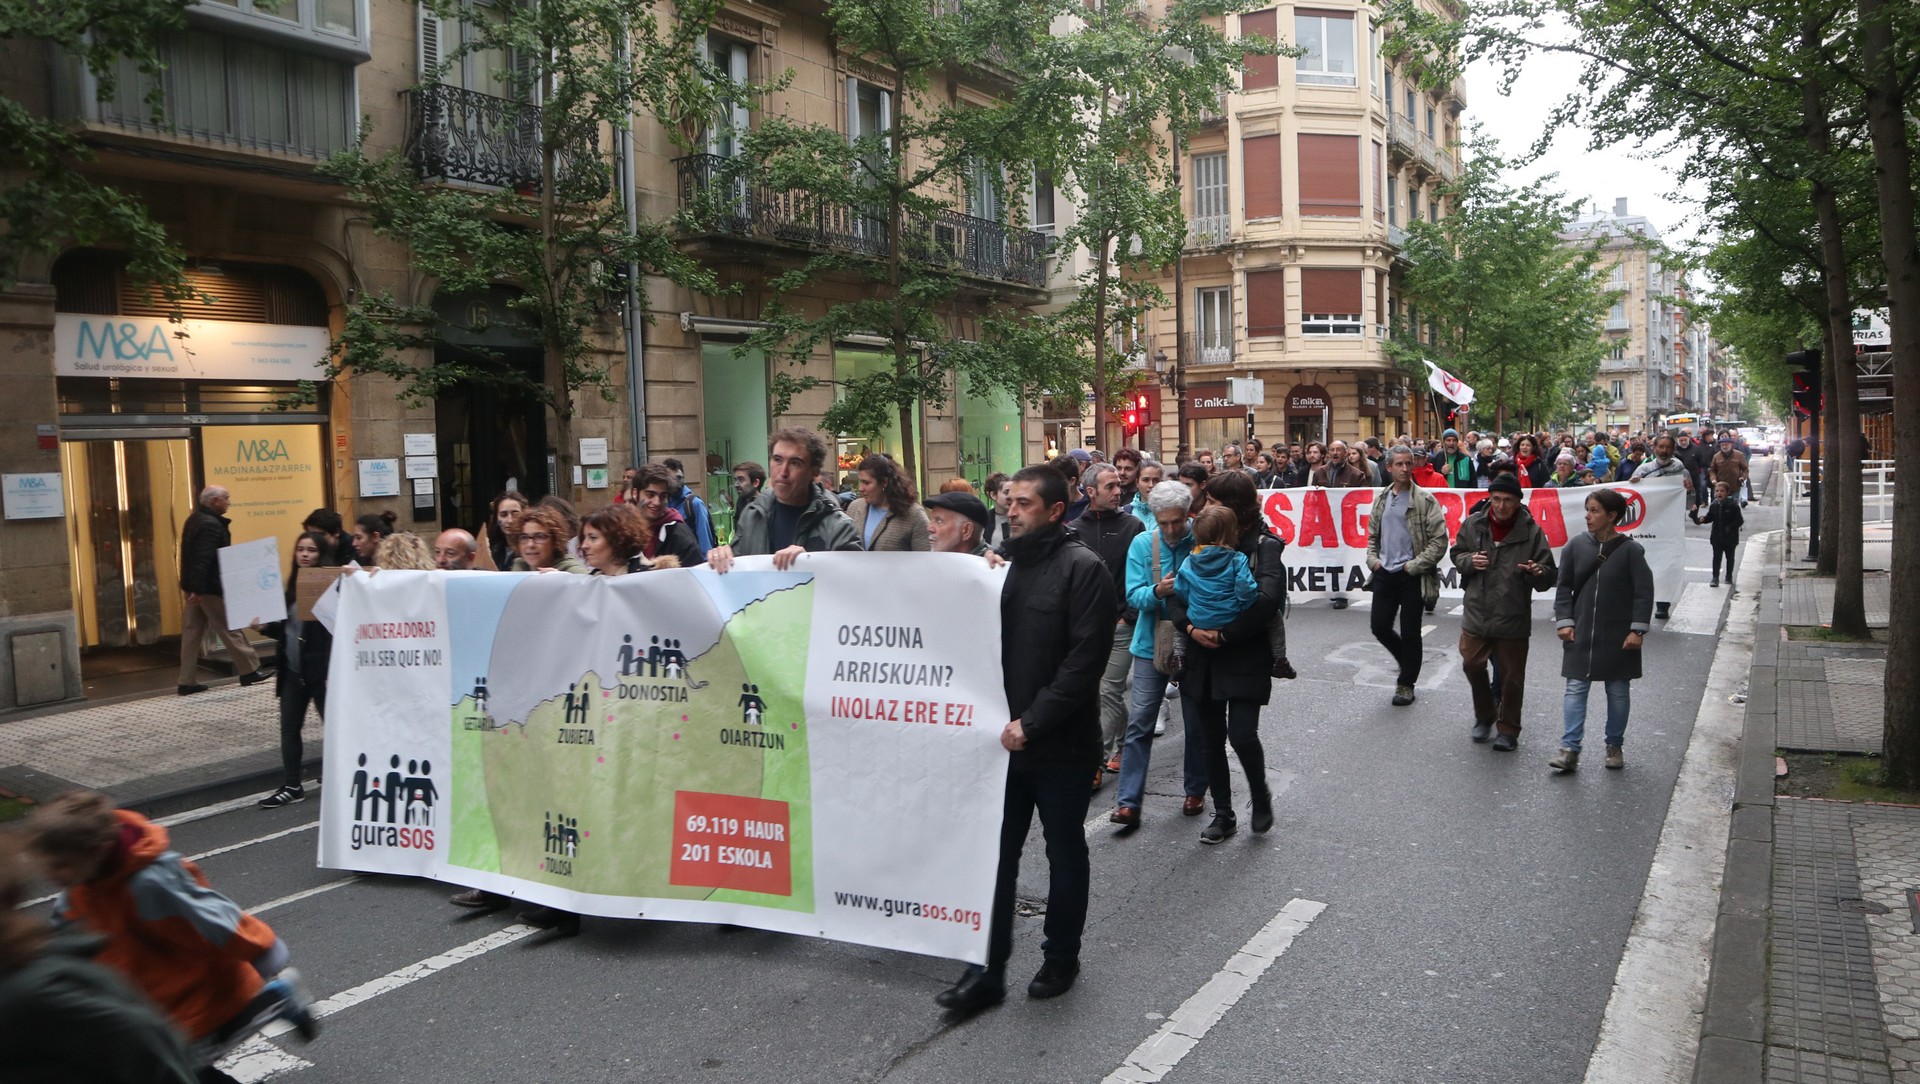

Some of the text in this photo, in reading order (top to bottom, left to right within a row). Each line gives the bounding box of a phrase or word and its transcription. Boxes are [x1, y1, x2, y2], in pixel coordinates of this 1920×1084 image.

[77, 320, 174, 361] M&A
[74, 362, 100, 371] Salud
[151, 364, 178, 373] sexual
[237, 439, 290, 462] M&A
[214, 463, 312, 475] MADINA&AZPARREN
[370, 462, 387, 470] M&A
[19, 478, 46, 489] M&A
[355, 621, 435, 644] ¿INCINERADORA?
[838, 624, 924, 649] OSASUNA
[378, 650, 397, 667] SER
[398, 649, 420, 668] QUE
[423, 649, 442, 666] NO!
[833, 660, 954, 688] ARRISKUAN?
[618, 684, 689, 703] DONOSTIA
[831, 696, 974, 727] INOLAZ ERE EZ!
[464, 717, 496, 731] GETARIA
[557, 728, 595, 745] ZUBIETA
[720, 728, 785, 750] OIARTZUN
[351, 824, 435, 850] gurasos
[686, 815, 785, 842] 69.119 HAUR
[545, 857, 572, 877] TOLOSA
[681, 843, 773, 869] 201 ESKOLA
[834, 891, 982, 932] www.gurasos.org
